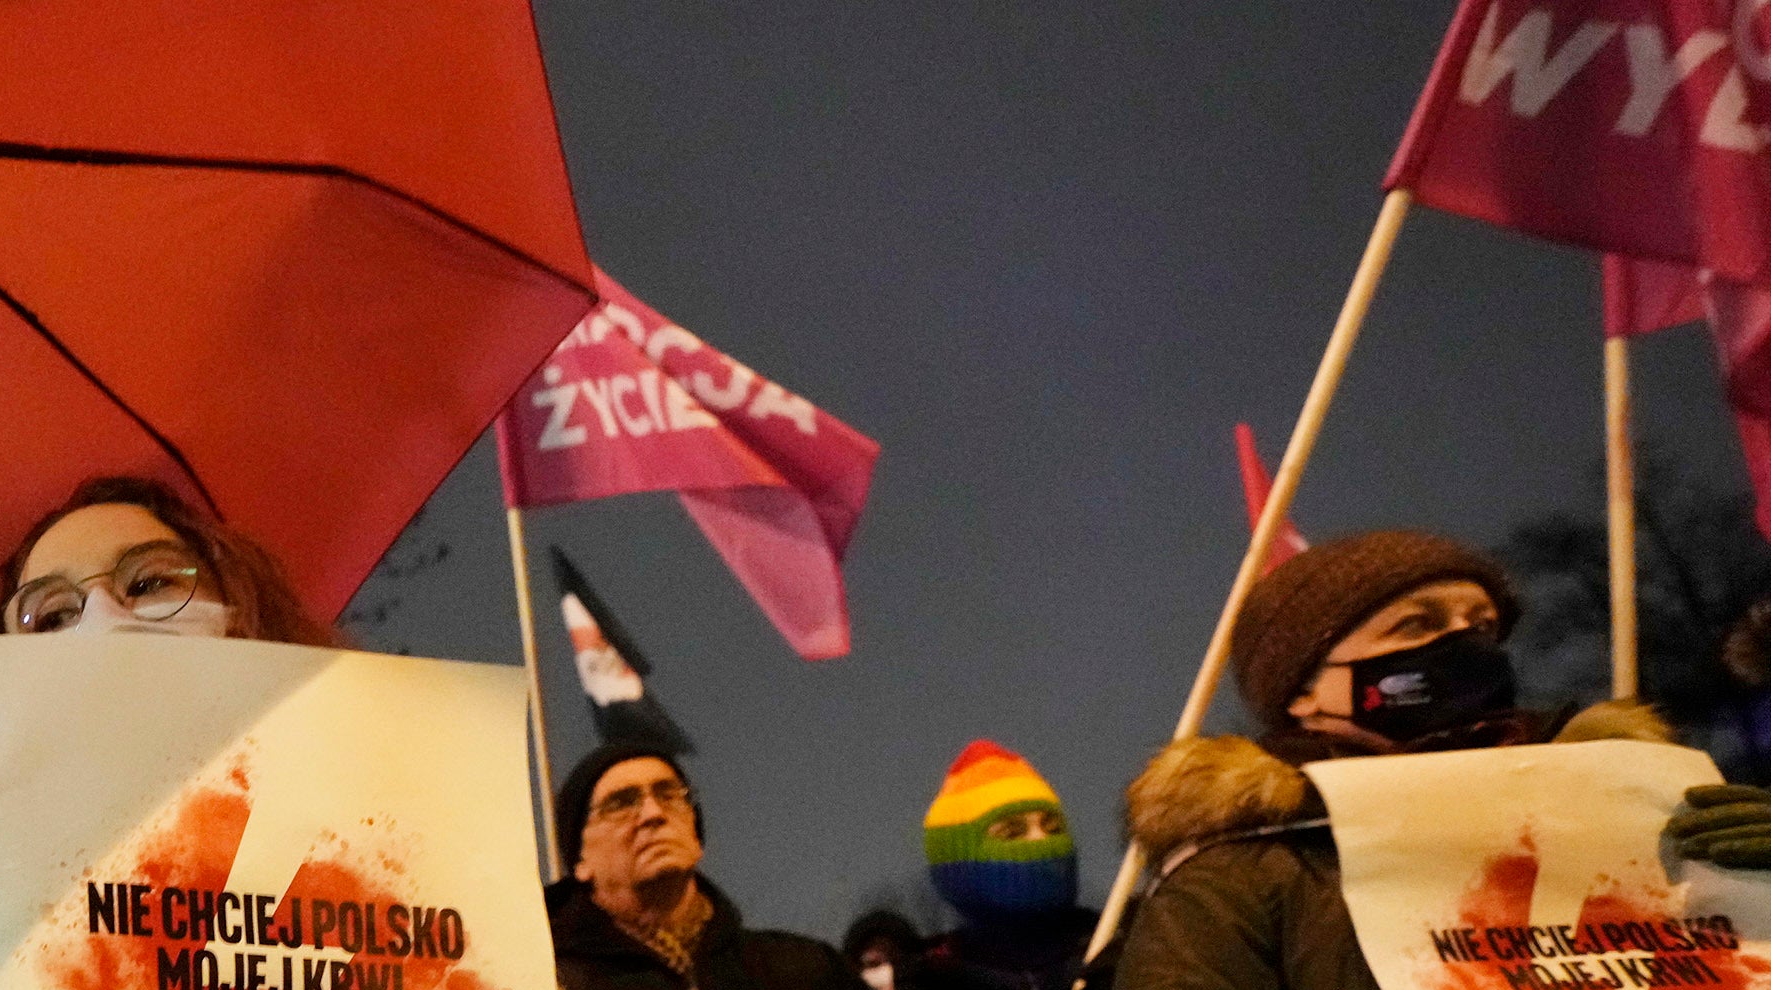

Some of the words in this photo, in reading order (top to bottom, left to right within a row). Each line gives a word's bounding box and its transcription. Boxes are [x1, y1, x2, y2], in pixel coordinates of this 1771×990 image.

[87, 882, 153, 938] NIE
[162, 886, 303, 949] CHCIEJ
[313, 899, 465, 960] POLSKO
[1431, 928, 1488, 962] NIE
[1487, 924, 1607, 961] CHCIEJ
[1605, 914, 1740, 956] POLSKO
[1618, 954, 1722, 988] KRWI
